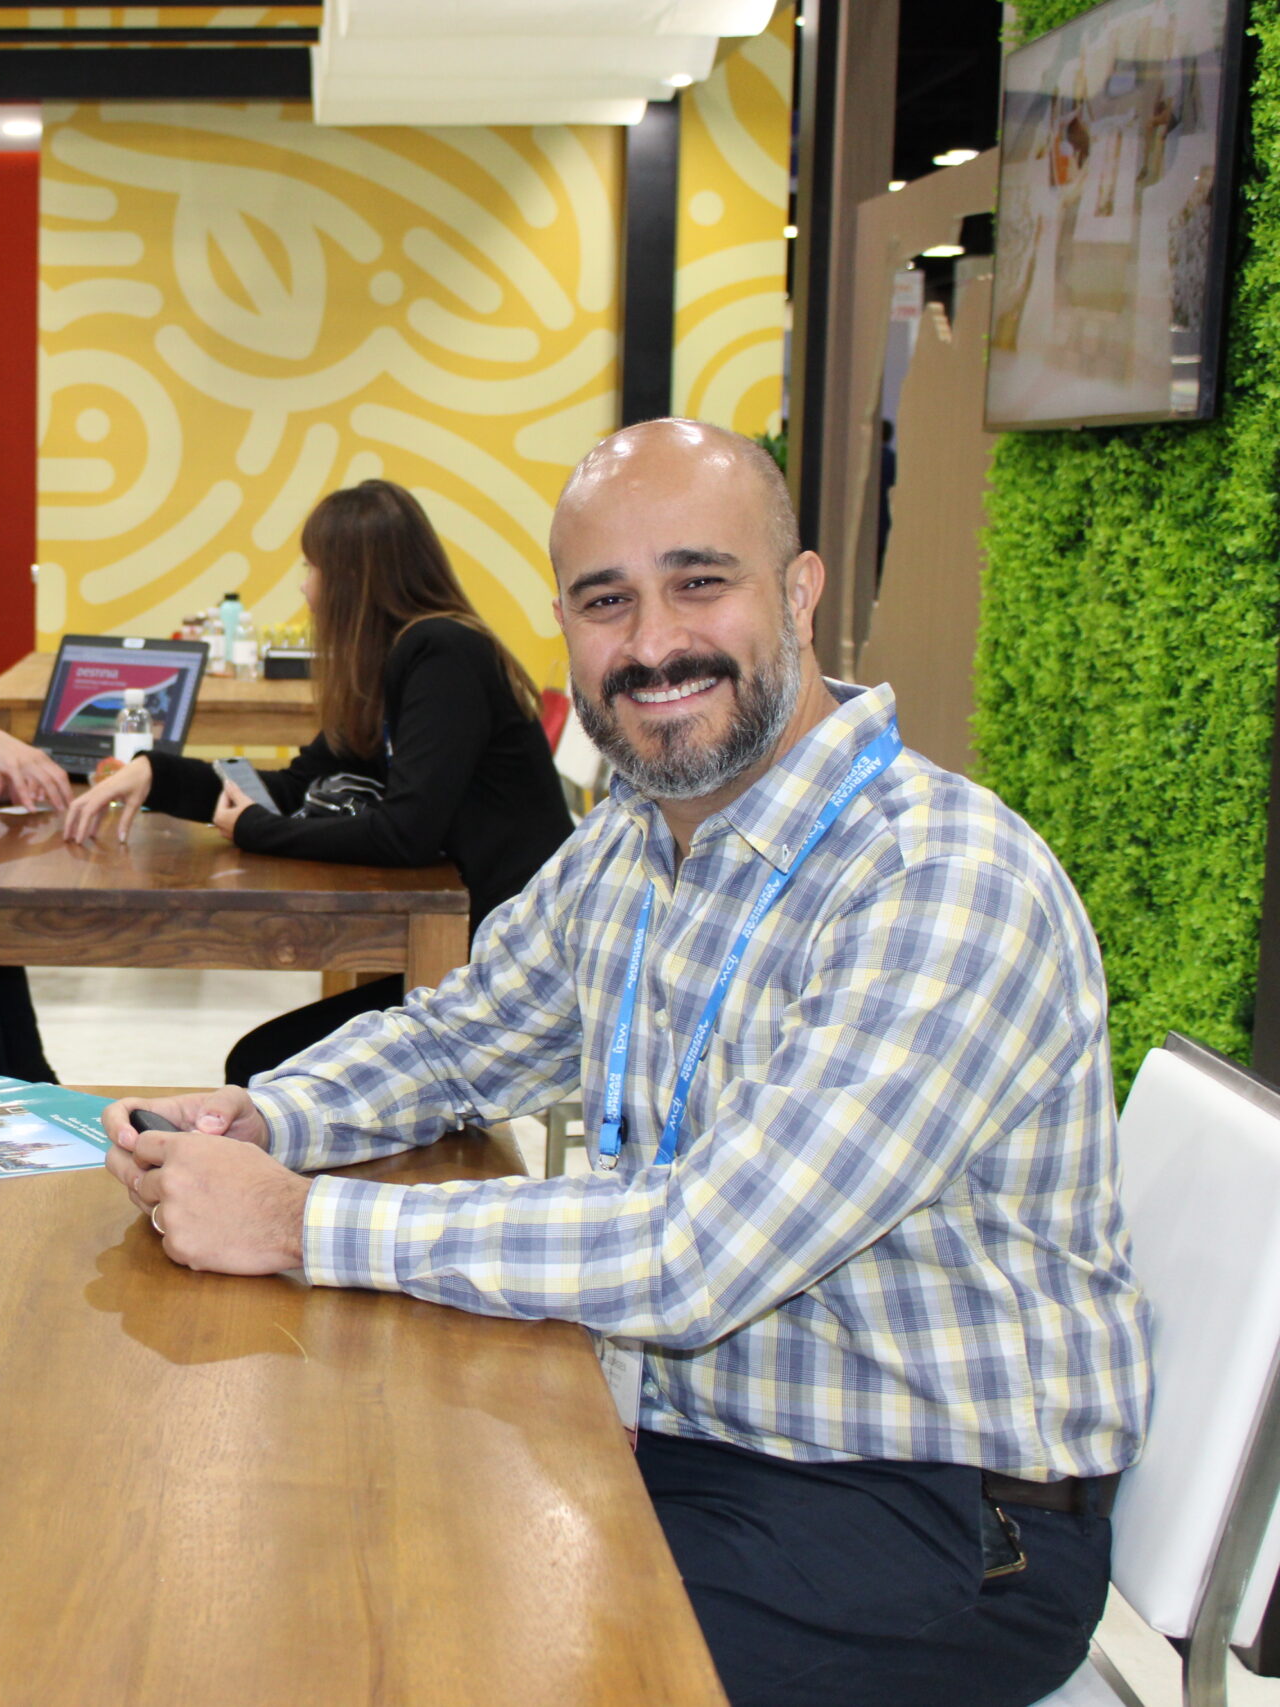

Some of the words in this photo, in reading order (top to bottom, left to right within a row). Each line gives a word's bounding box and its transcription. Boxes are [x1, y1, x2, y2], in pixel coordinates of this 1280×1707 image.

[829, 756, 871, 803] EXPRESS
[835, 757, 882, 807] AMERICAN
[719, 953, 739, 987] ipw
[613, 1022, 628, 1054] ipw
[669, 1097, 683, 1131] ipw
